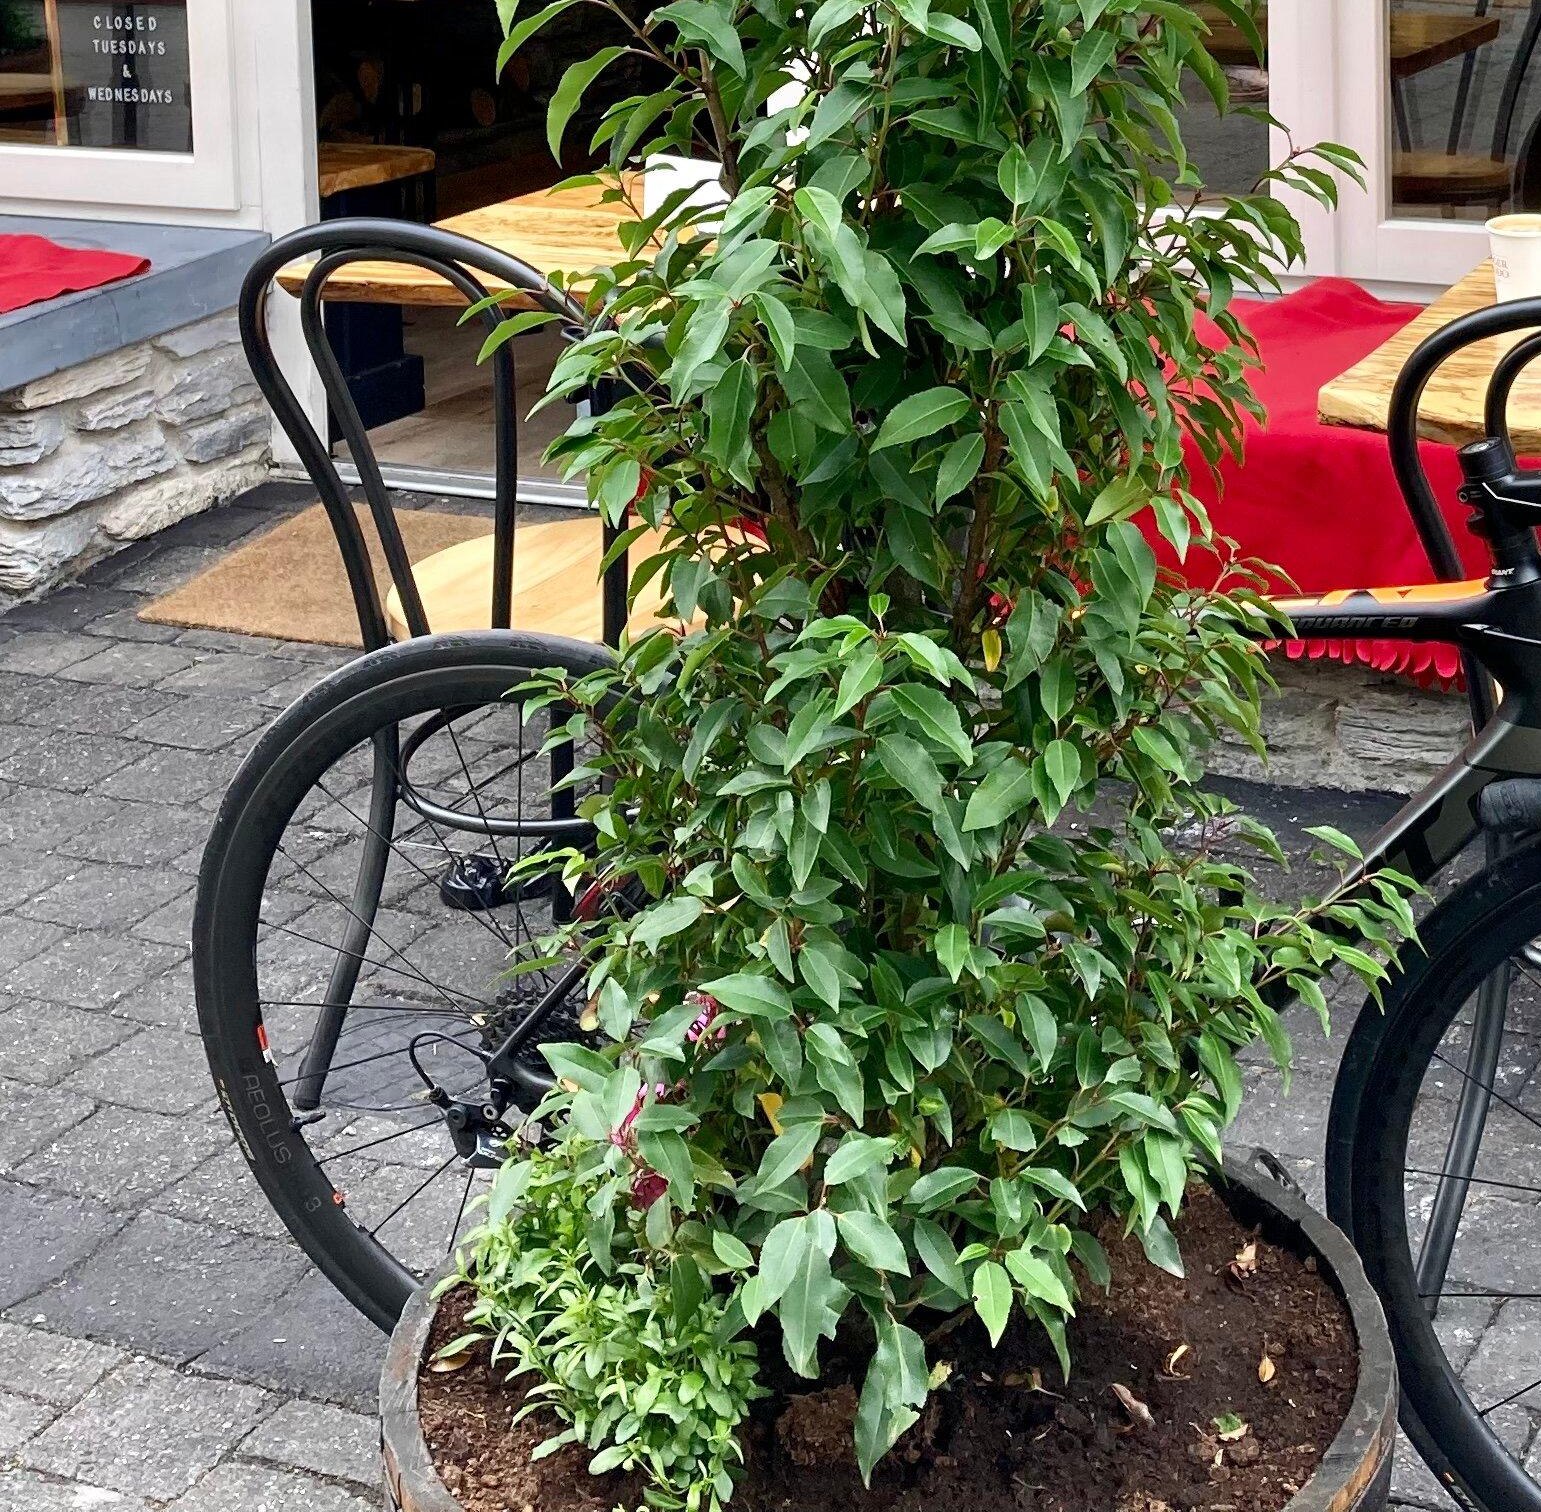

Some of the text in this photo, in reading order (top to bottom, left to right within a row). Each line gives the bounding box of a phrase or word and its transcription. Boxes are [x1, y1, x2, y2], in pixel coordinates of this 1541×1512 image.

[93, 15, 157, 31] CLOSED
[92, 39, 166, 55] TUESDAYS
[122, 64, 132, 78] &
[88, 87, 173, 103] WEDNESDAYS
[242, 1074, 292, 1164] AEOLUS
